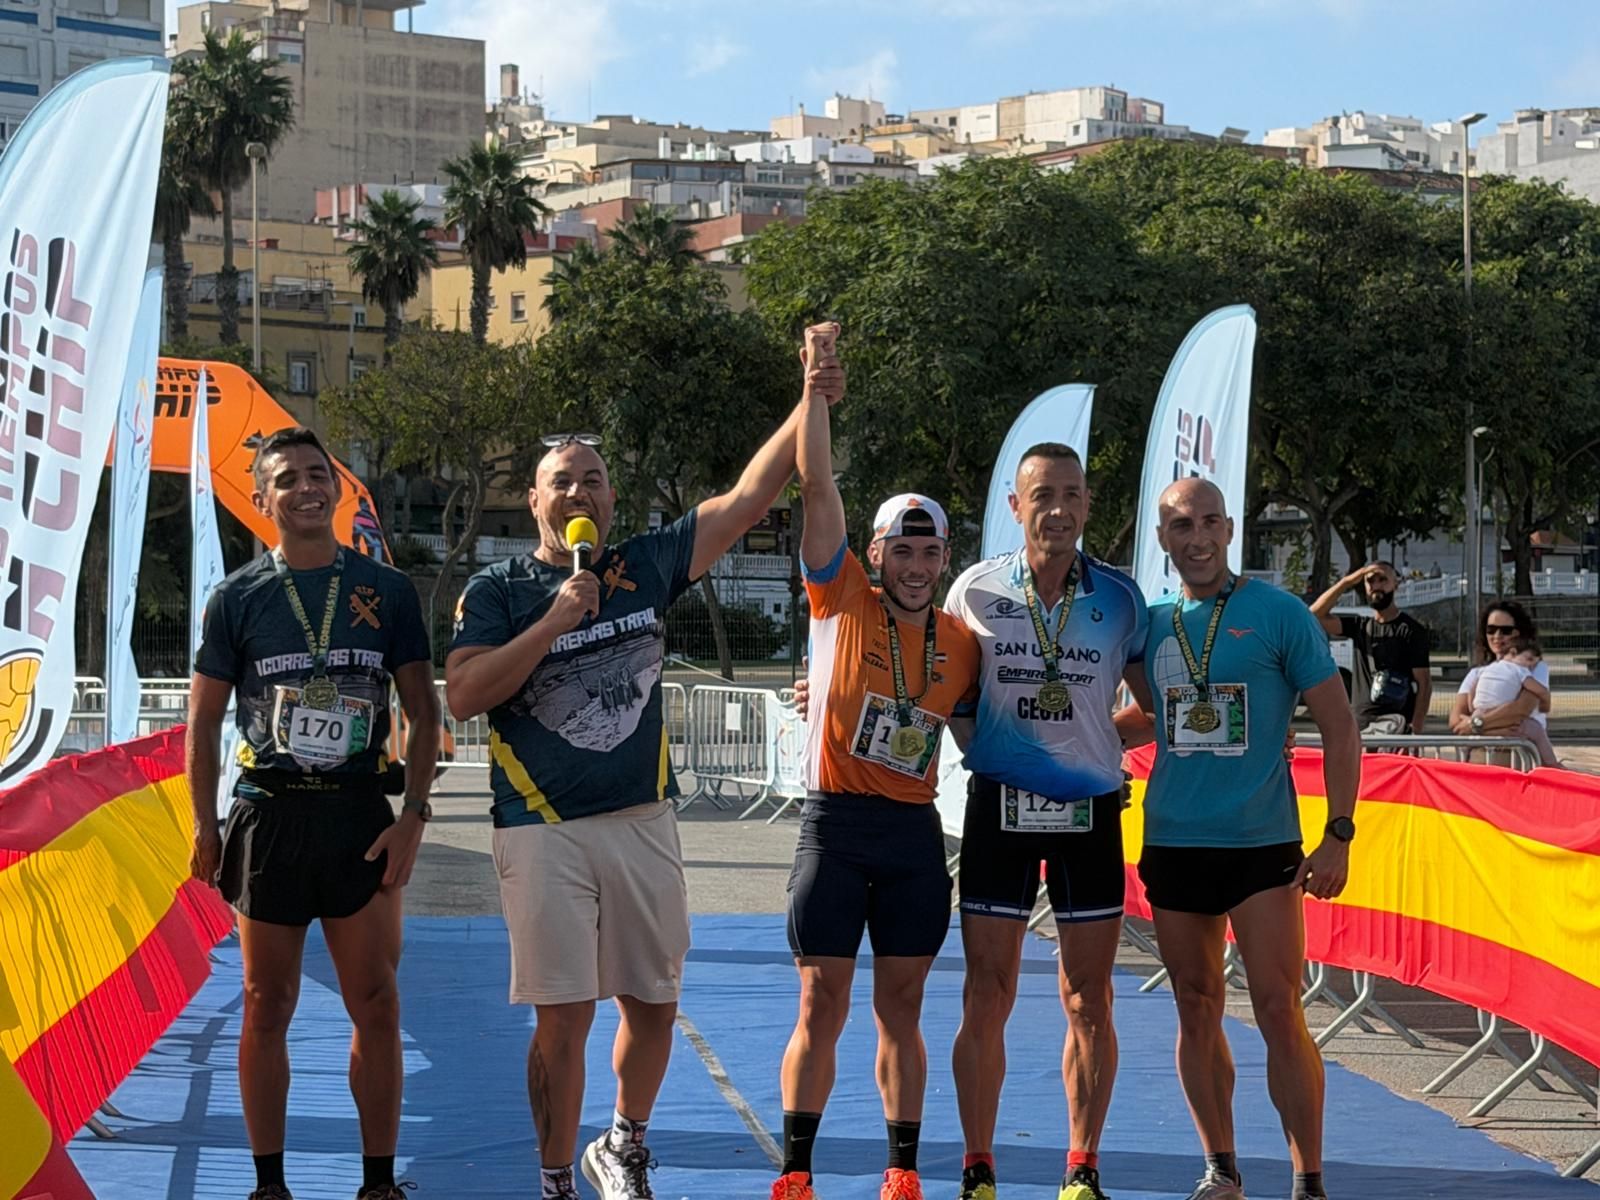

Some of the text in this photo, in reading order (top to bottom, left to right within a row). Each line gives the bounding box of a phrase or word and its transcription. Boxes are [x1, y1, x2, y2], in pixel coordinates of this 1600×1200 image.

[22, 237, 92, 531] CHIP
[615, 607, 657, 633] TRAIL
[351, 648, 384, 669] TRAIL
[994, 642, 1102, 664] SAN UBANO
[297, 716, 344, 741] 170
